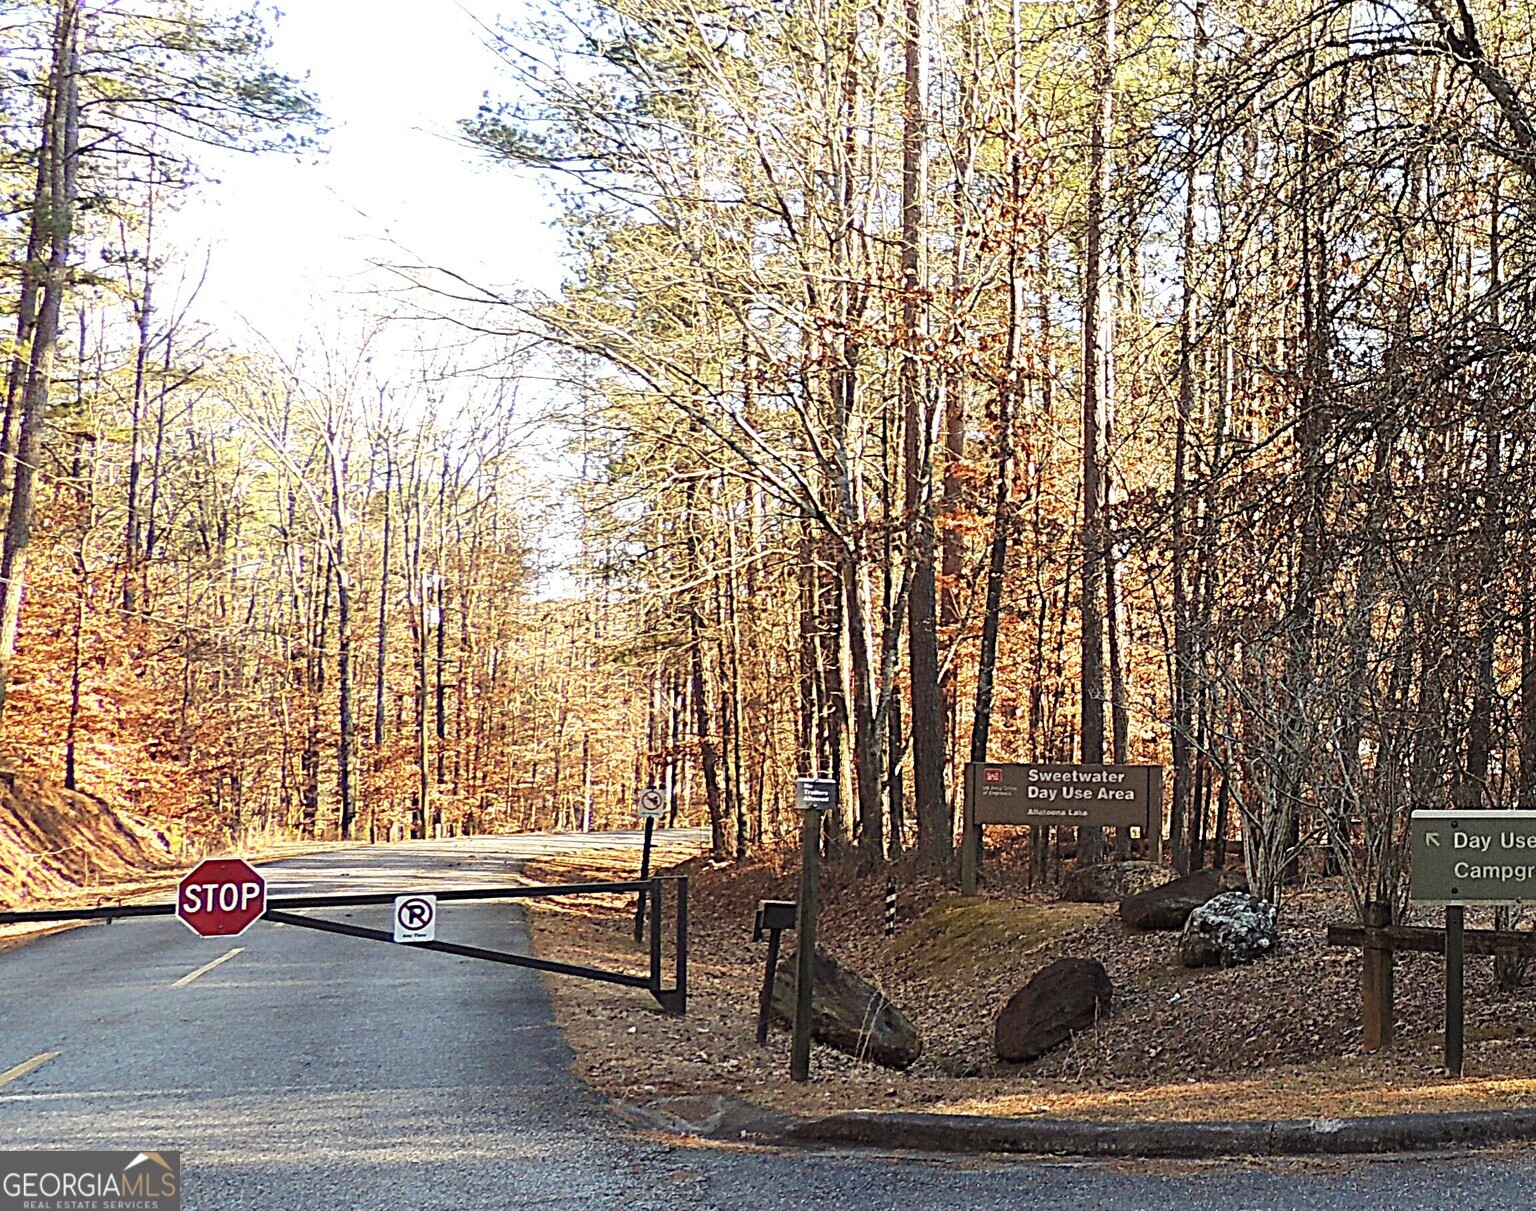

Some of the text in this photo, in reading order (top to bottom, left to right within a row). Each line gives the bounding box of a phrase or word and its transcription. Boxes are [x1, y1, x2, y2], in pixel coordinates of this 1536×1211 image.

[1028, 769, 1125, 783] Sweetwater
[1028, 786, 1058, 801] Day
[1062, 786, 1093, 799] Use
[1097, 787, 1135, 800] Area
[1027, 808, 1066, 816] Allatoona
[1453, 832, 1491, 852] Day
[183, 882, 261, 914] STOP
